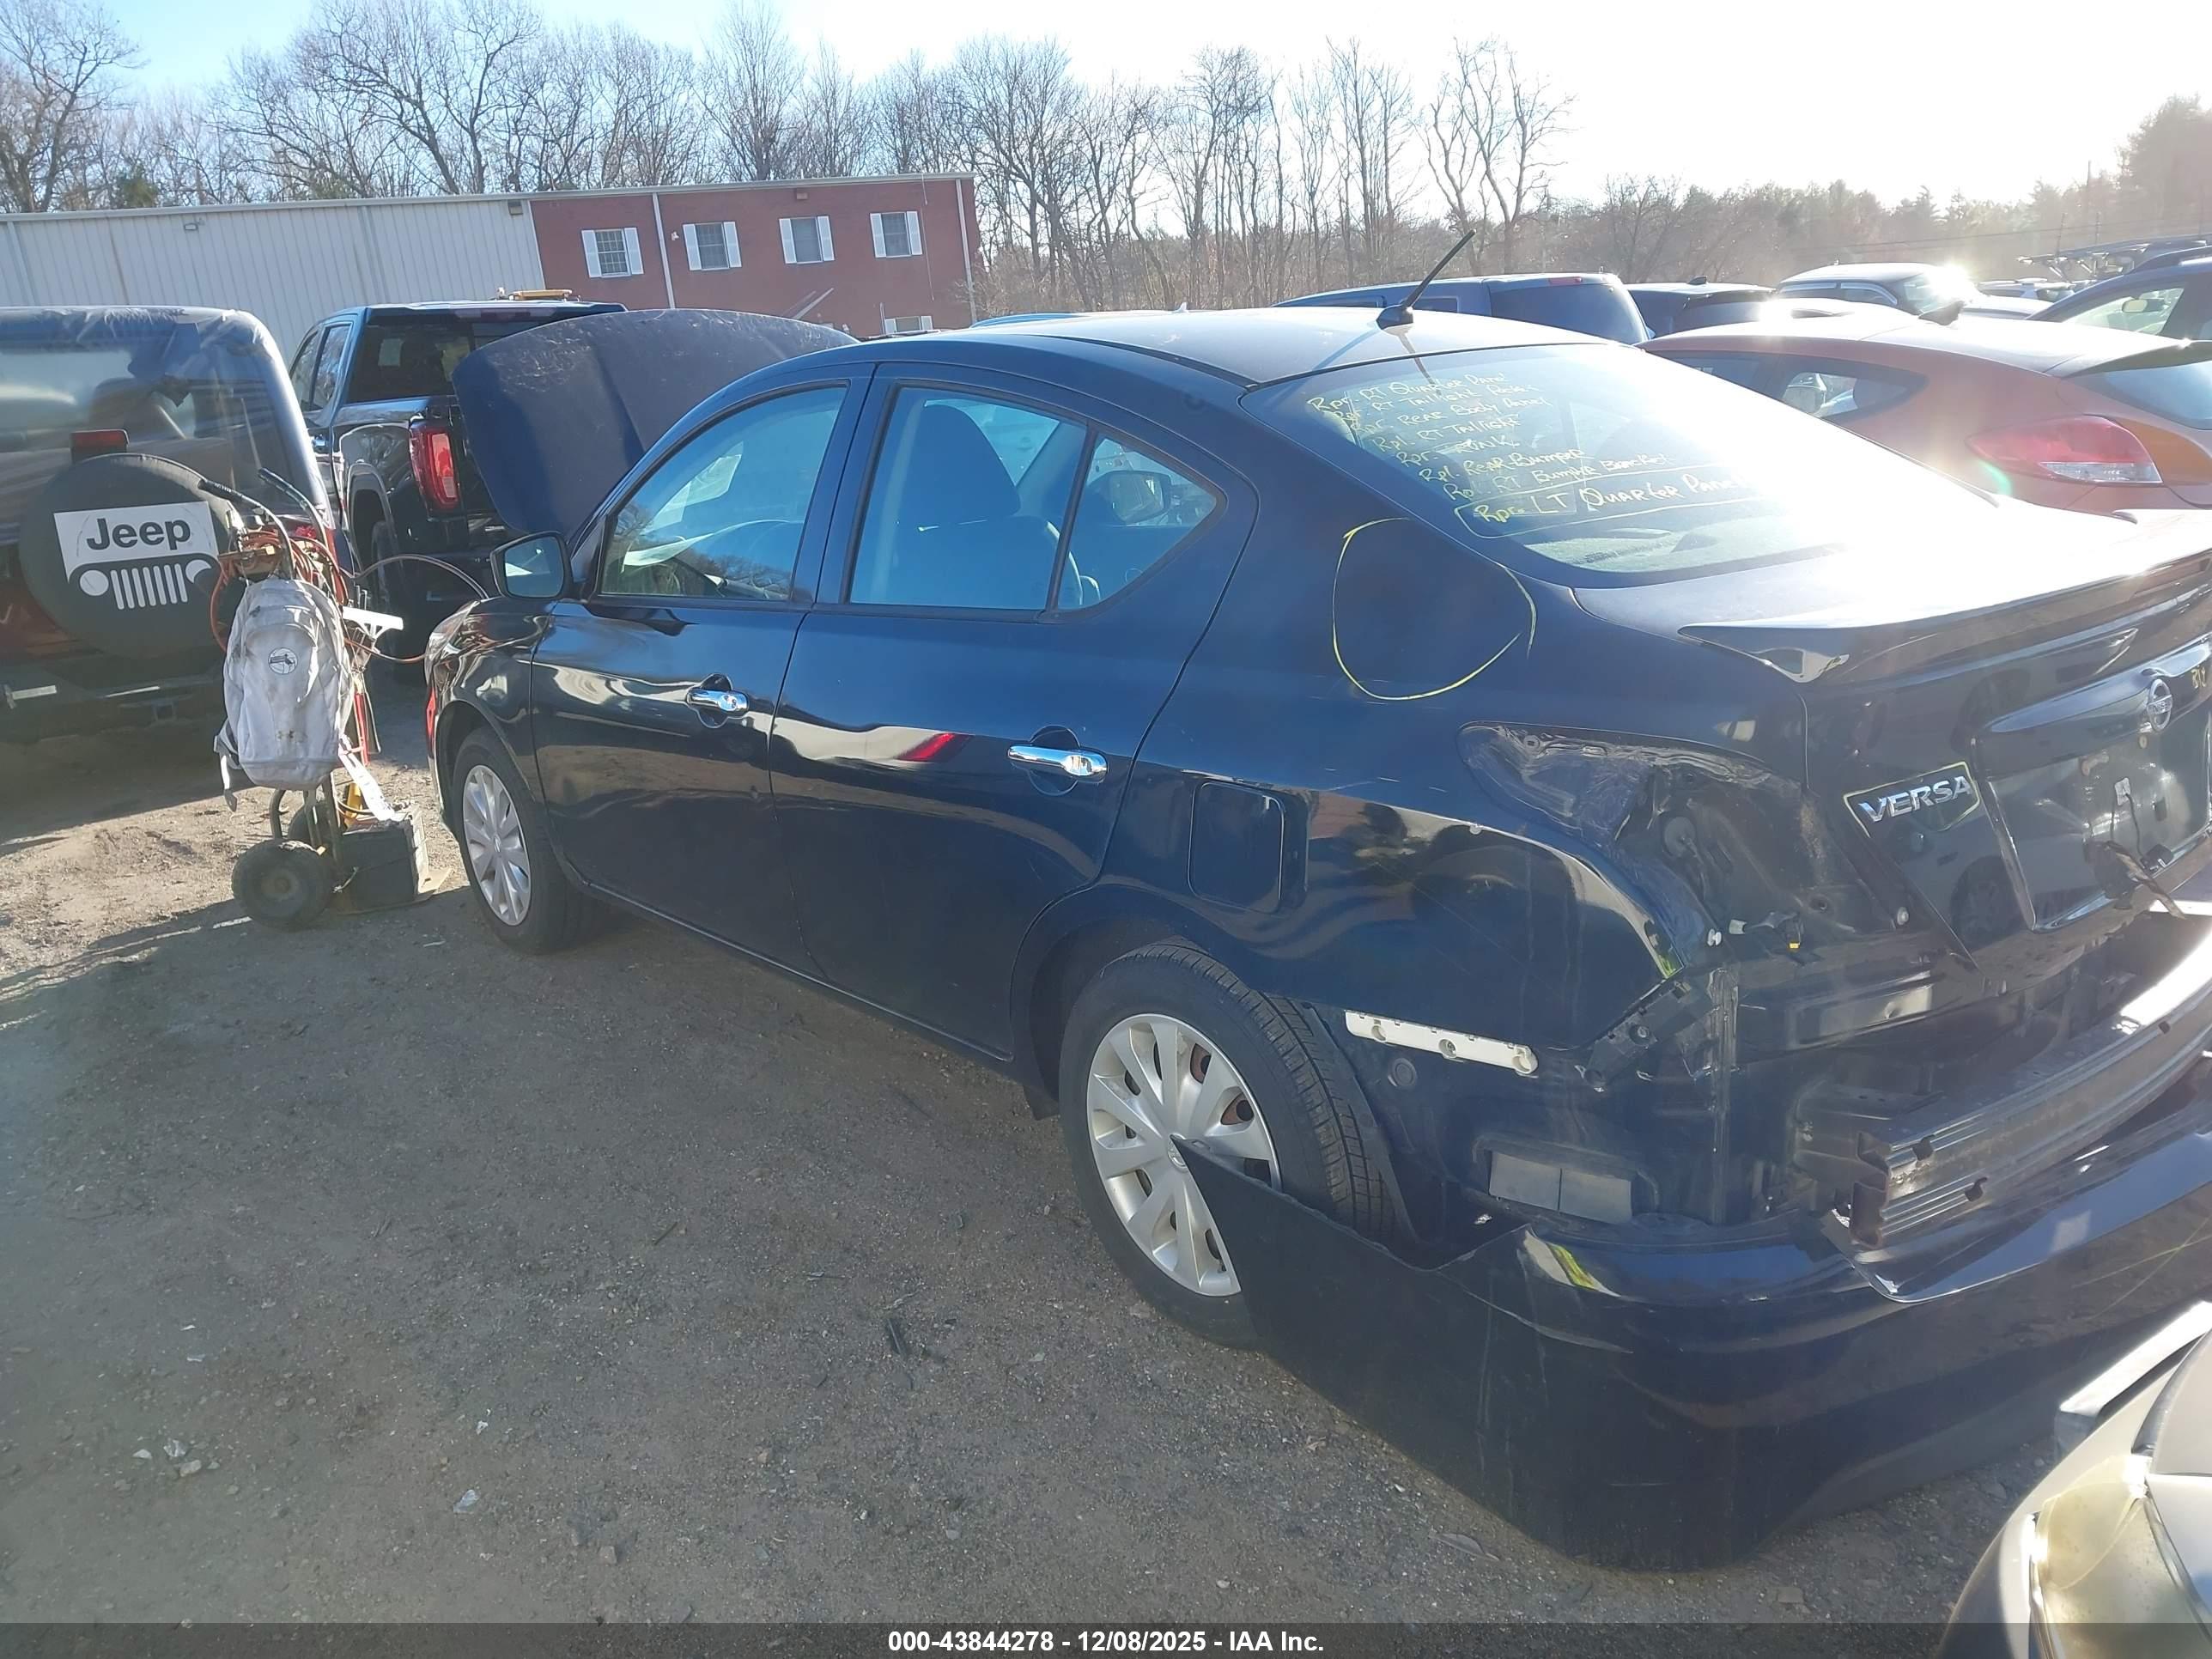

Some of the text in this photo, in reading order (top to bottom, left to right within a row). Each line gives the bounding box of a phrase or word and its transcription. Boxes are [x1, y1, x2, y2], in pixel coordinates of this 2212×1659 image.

[1358, 386, 1389, 402] RT
[1372, 400, 1395, 412] RT
[1417, 429, 1444, 441] RT
[1493, 475, 1522, 494] RT
[1530, 492, 1570, 514] LT
[87, 516, 191, 550] Jeep
[1857, 775, 1974, 823] VERSA
